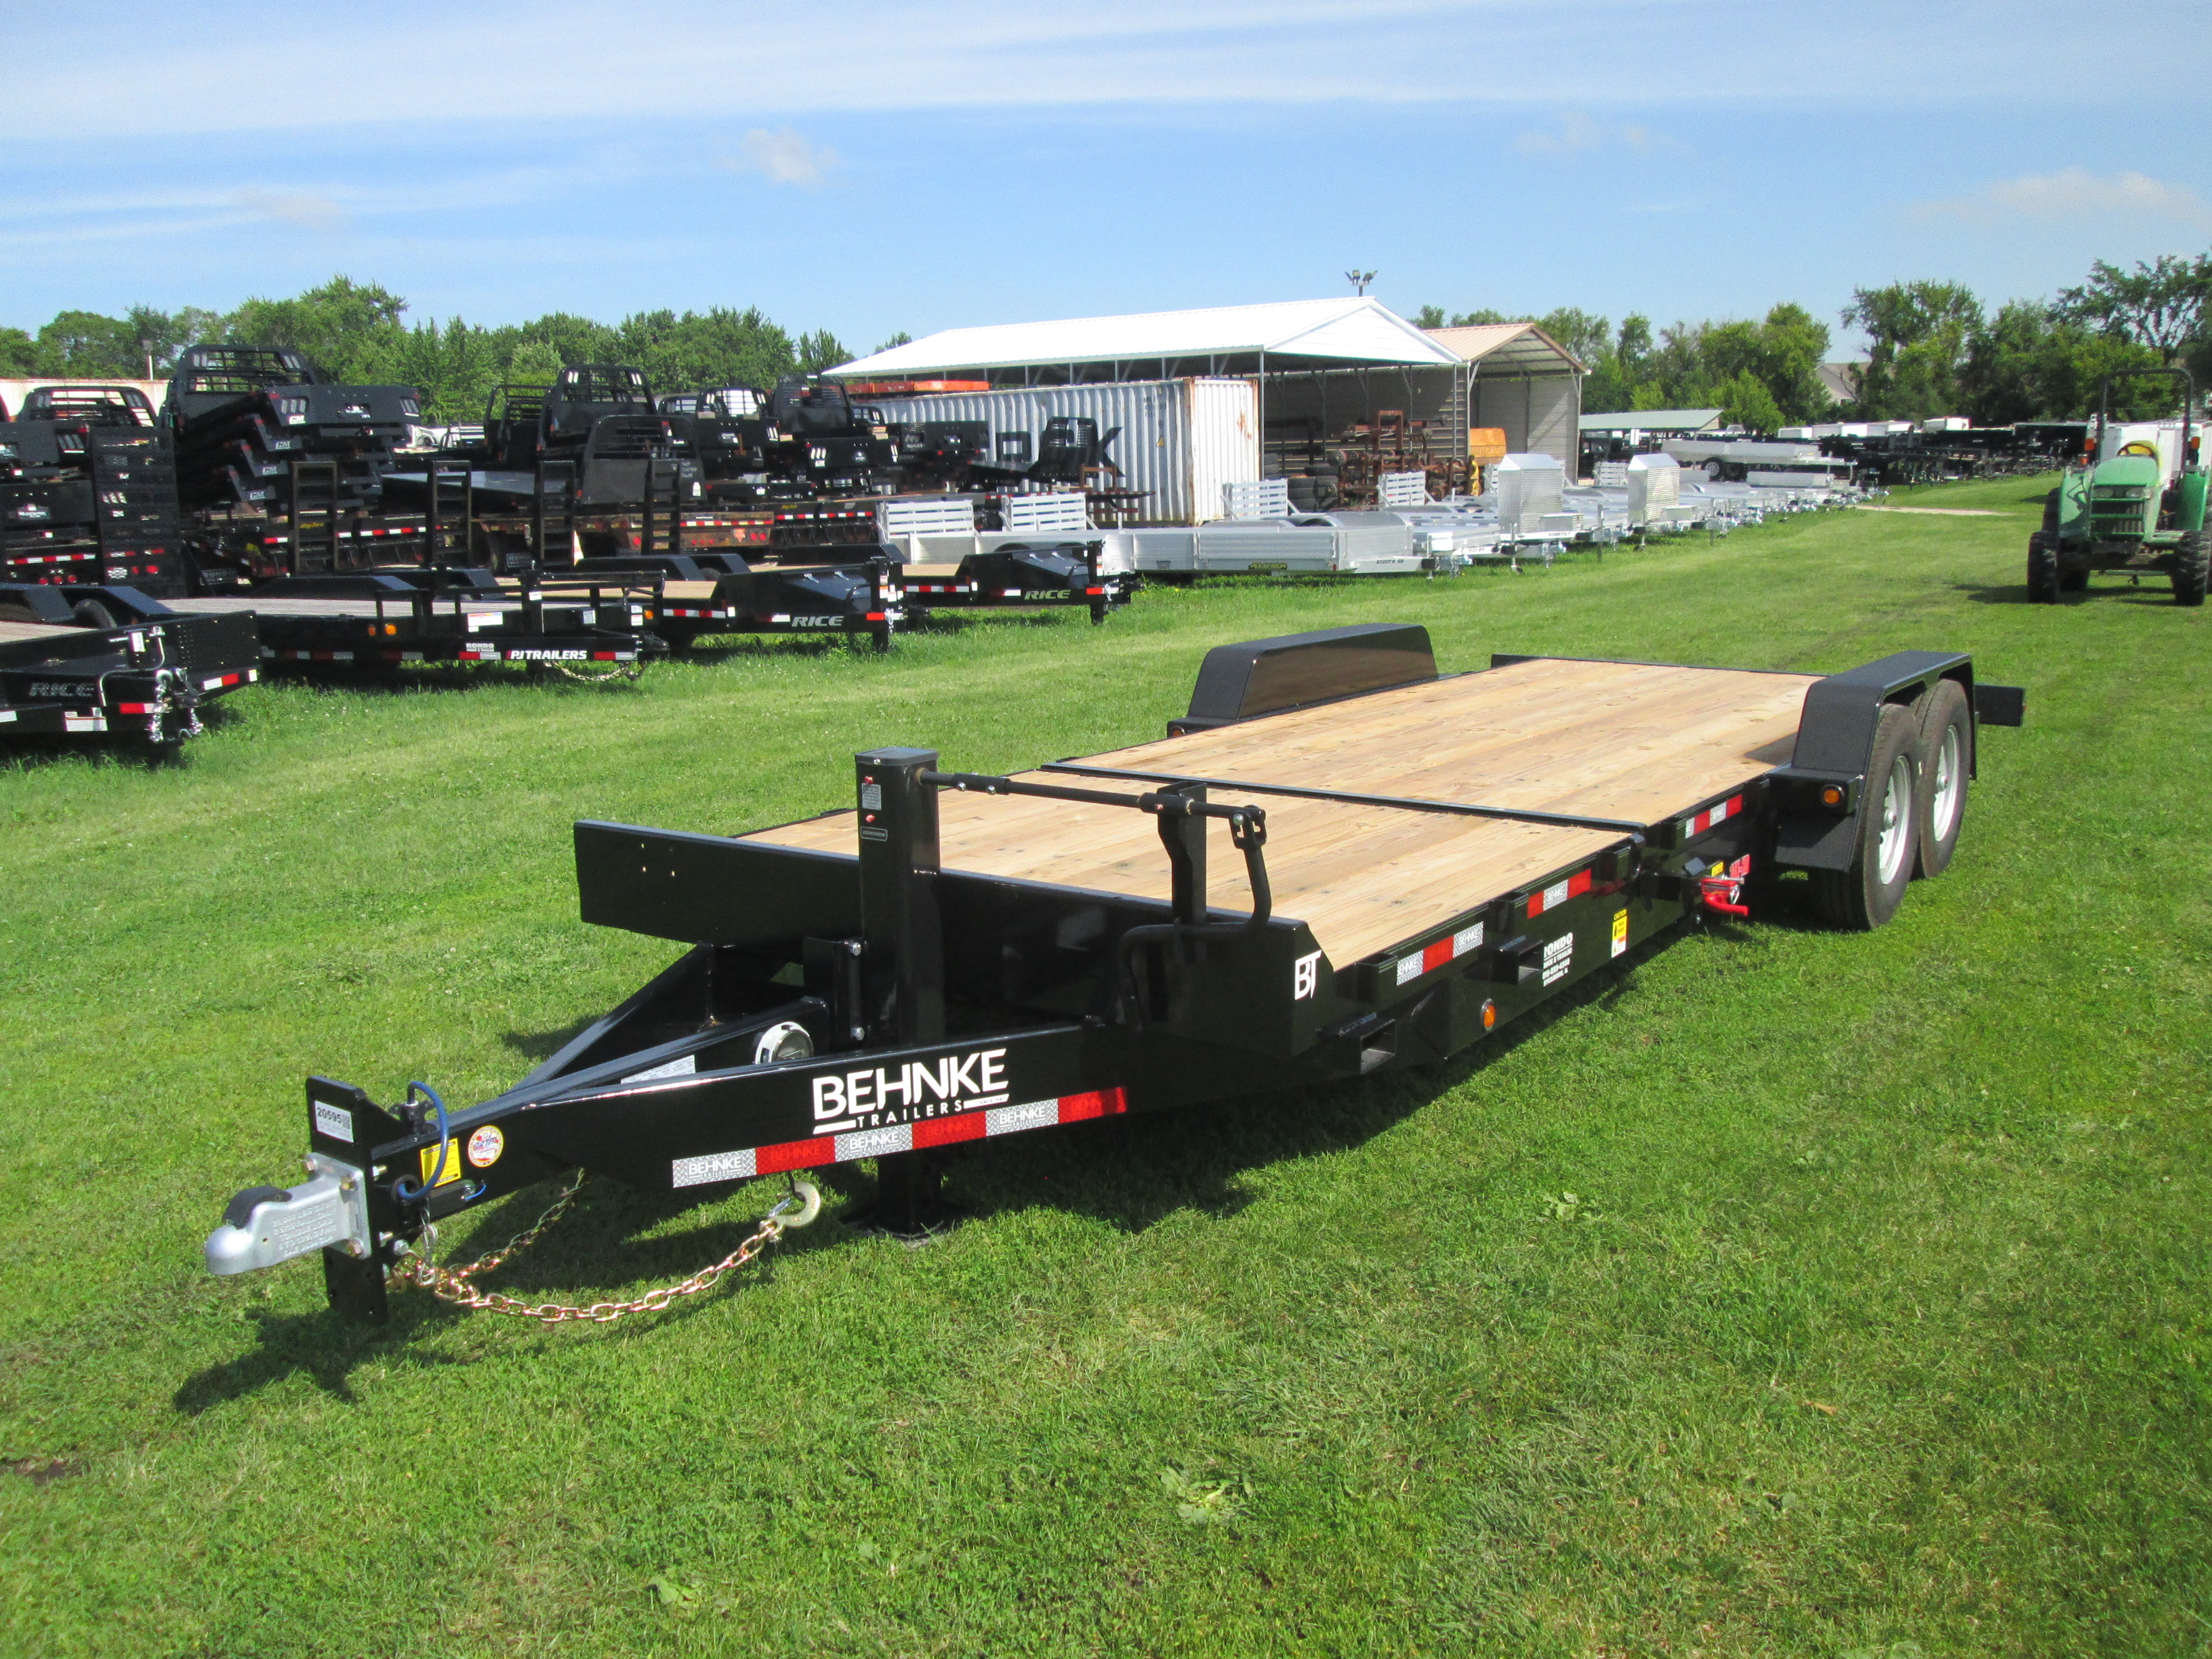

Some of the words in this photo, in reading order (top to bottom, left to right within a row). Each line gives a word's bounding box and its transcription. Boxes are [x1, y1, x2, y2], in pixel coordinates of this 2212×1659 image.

[1024, 590, 1071, 600] RICE
[792, 615, 844, 627] RICE
[510, 651, 527, 659] PJ
[526, 651, 587, 659] TRAILERS
[29, 682, 94, 697] RICE
[1458, 929, 1479, 946] BEHNKE
[1294, 949, 1322, 1000] BT
[813, 1048, 1008, 1120] BEHNKE
[316, 1107, 342, 1124] 20595
[857, 1099, 963, 1128] TRAILERS
[999, 1107, 1046, 1124] BEHNKE
[849, 1131, 899, 1150] BEHNKE
[688, 1156, 743, 1175] BEHNKE
